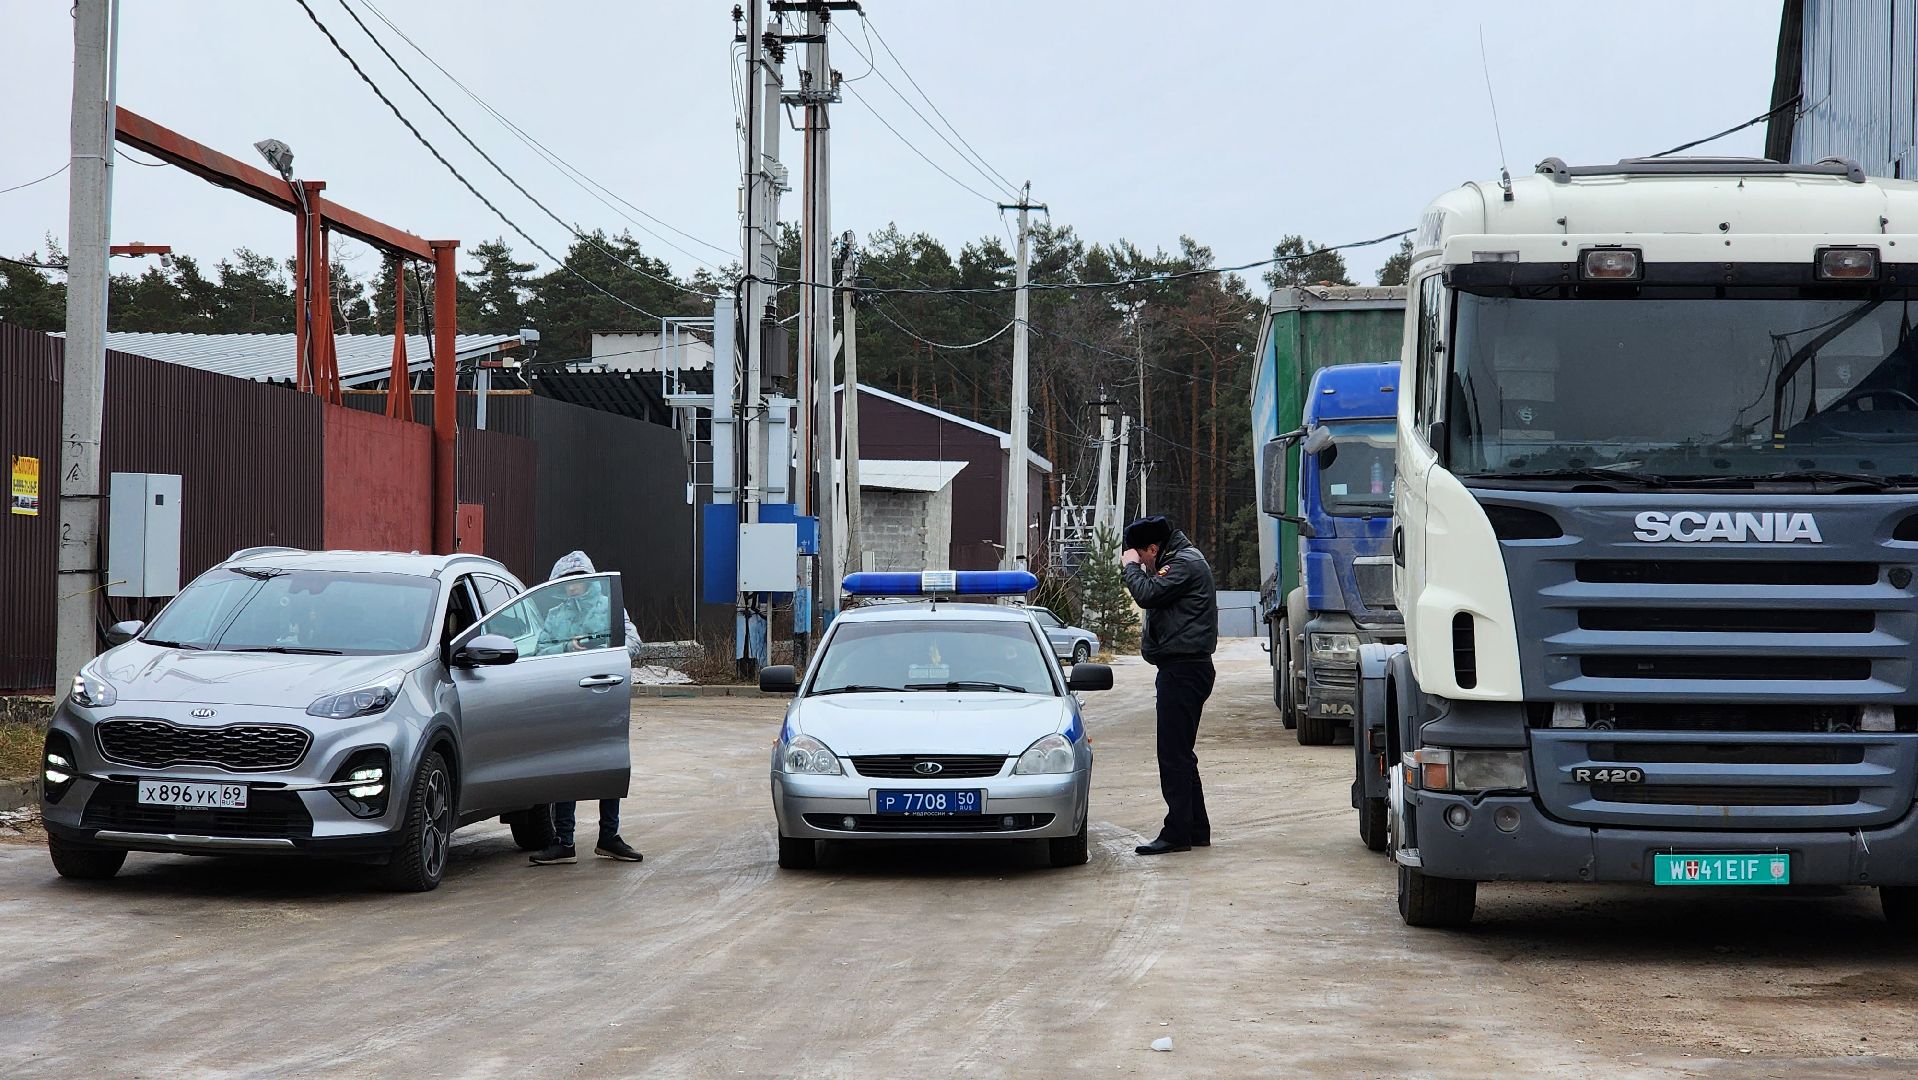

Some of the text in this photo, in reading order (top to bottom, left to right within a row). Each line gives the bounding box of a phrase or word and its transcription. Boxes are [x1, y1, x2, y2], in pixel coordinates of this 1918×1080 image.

[1633, 511, 1823, 543] SCANIA
[193, 709, 212, 717] KIA
[1321, 703, 1355, 715] MA
[1576, 769, 1641, 783] R 420
[223, 786, 241, 800] 69
[903, 793, 947, 810] 7708
[958, 792, 975, 805] 50
